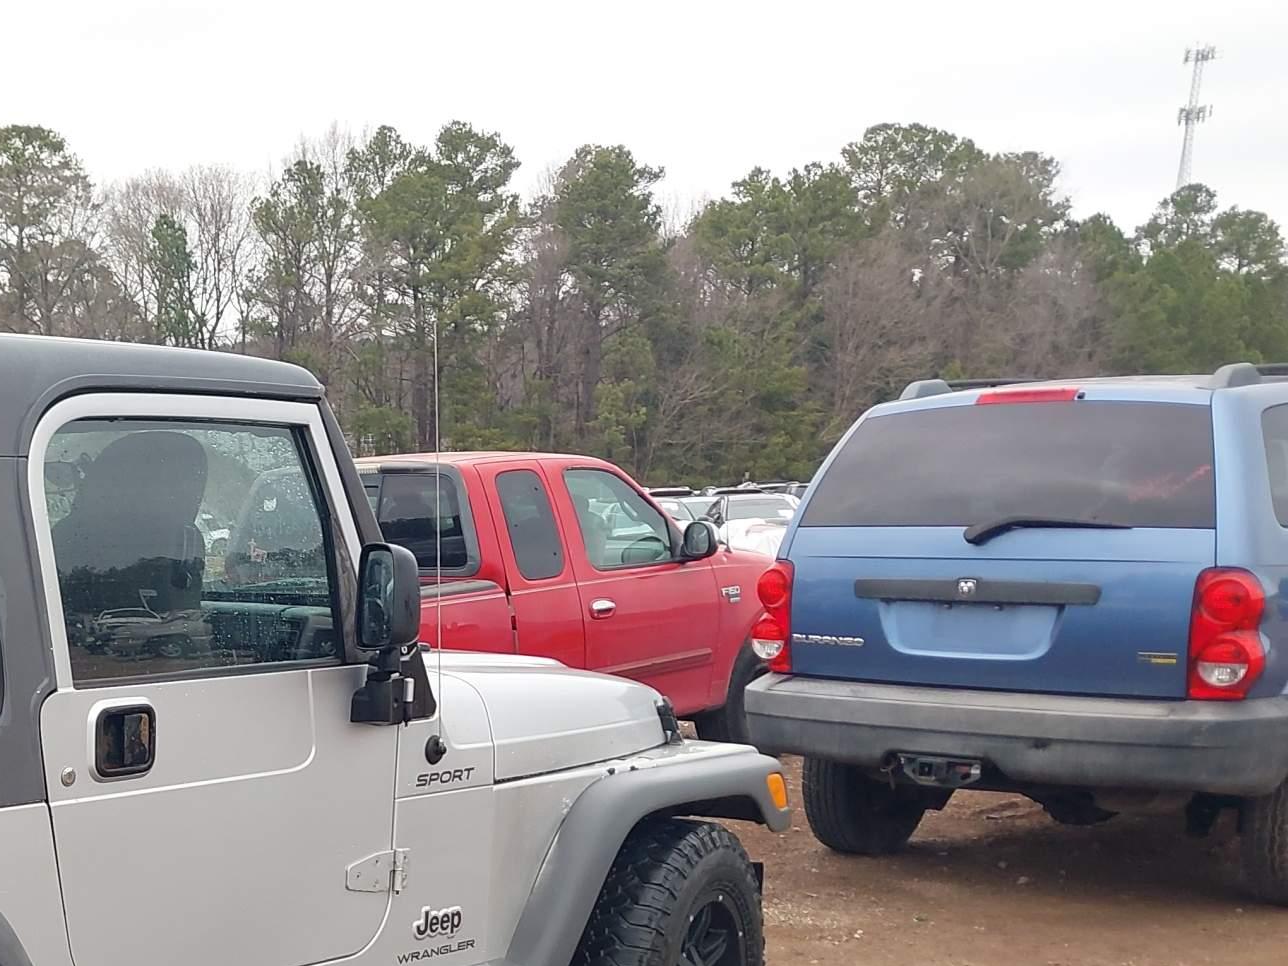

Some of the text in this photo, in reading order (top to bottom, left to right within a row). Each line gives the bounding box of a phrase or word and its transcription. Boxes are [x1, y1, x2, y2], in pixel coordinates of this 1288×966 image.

[416, 767, 475, 787] SPORT
[414, 907, 462, 938] Jeep
[397, 939, 475, 964] WRANGLER
